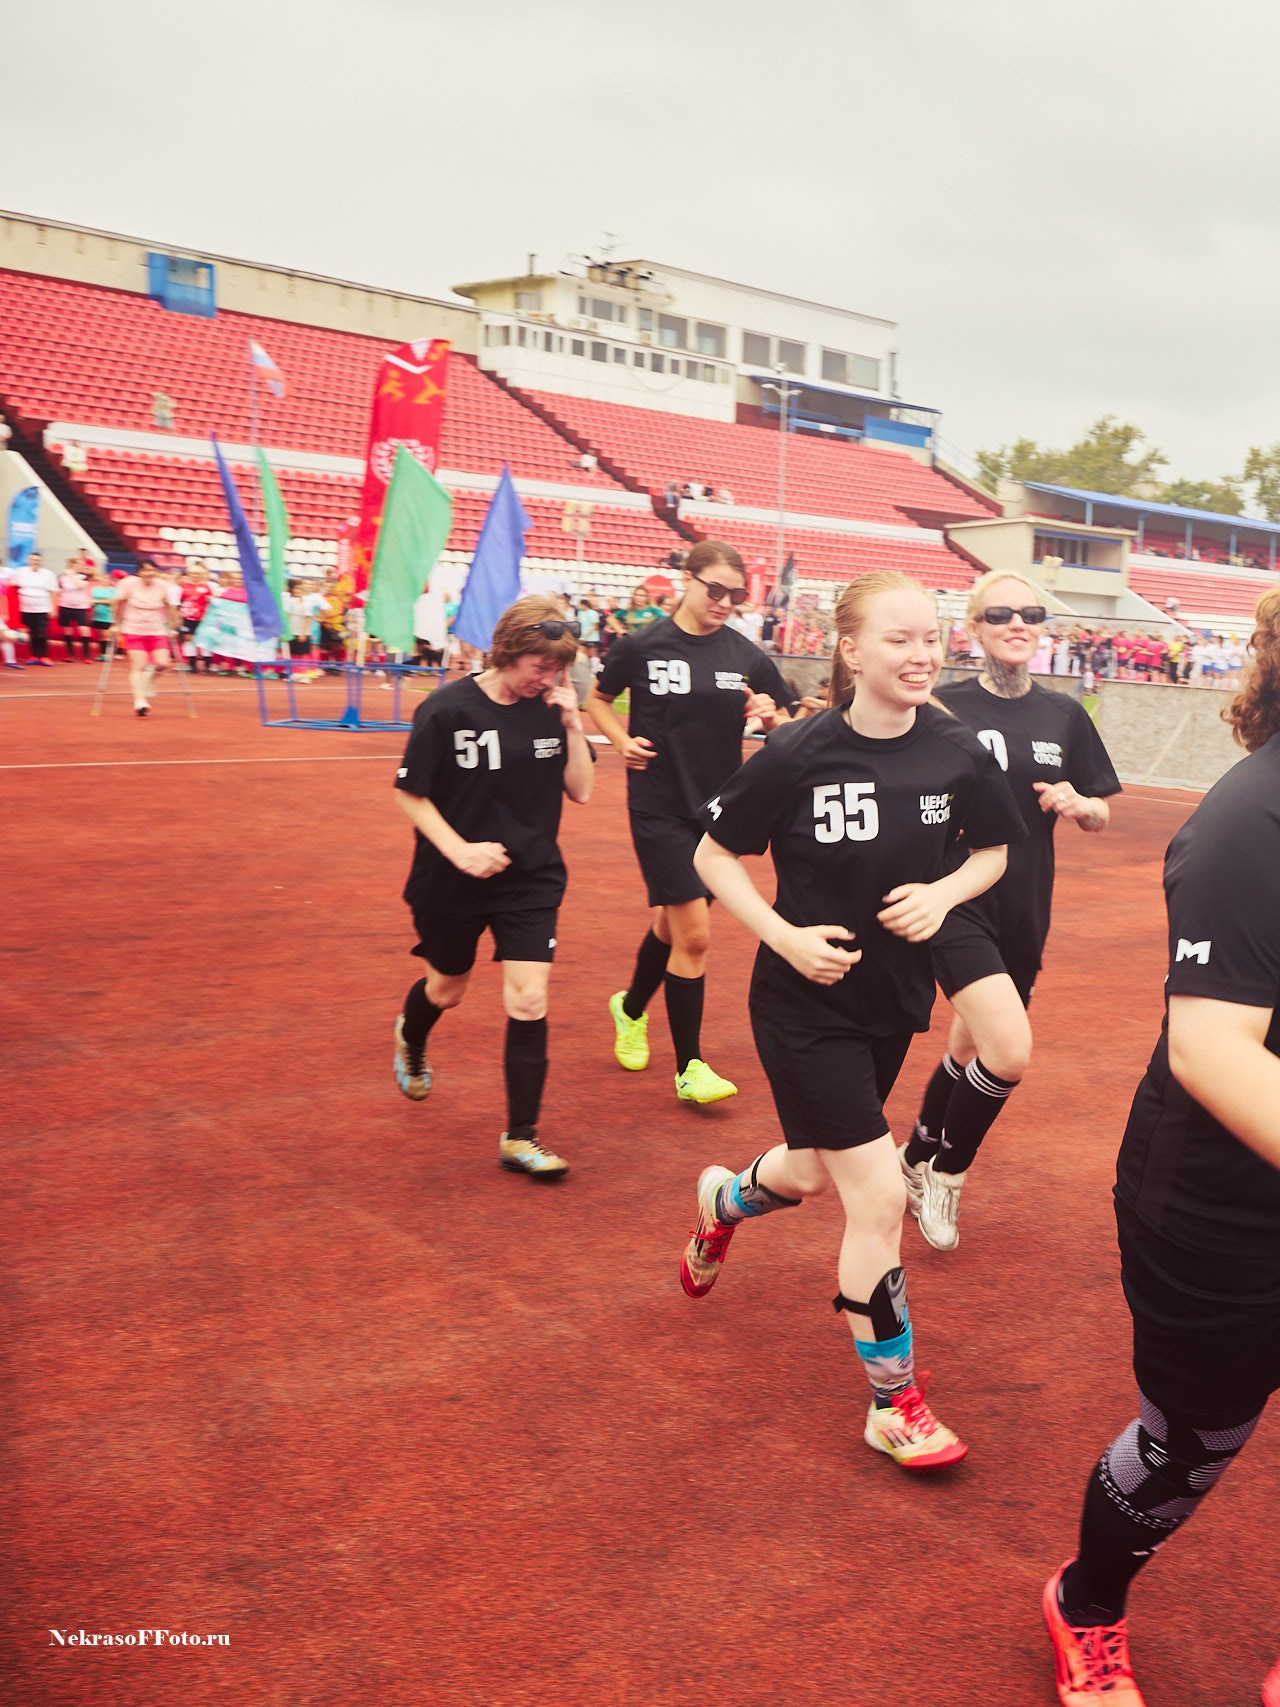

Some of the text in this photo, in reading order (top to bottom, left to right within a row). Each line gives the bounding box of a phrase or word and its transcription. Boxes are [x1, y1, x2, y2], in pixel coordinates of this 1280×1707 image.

[647, 659, 692, 696] 59
[454, 729, 502, 770] 51
[813, 782, 879, 844] 55
